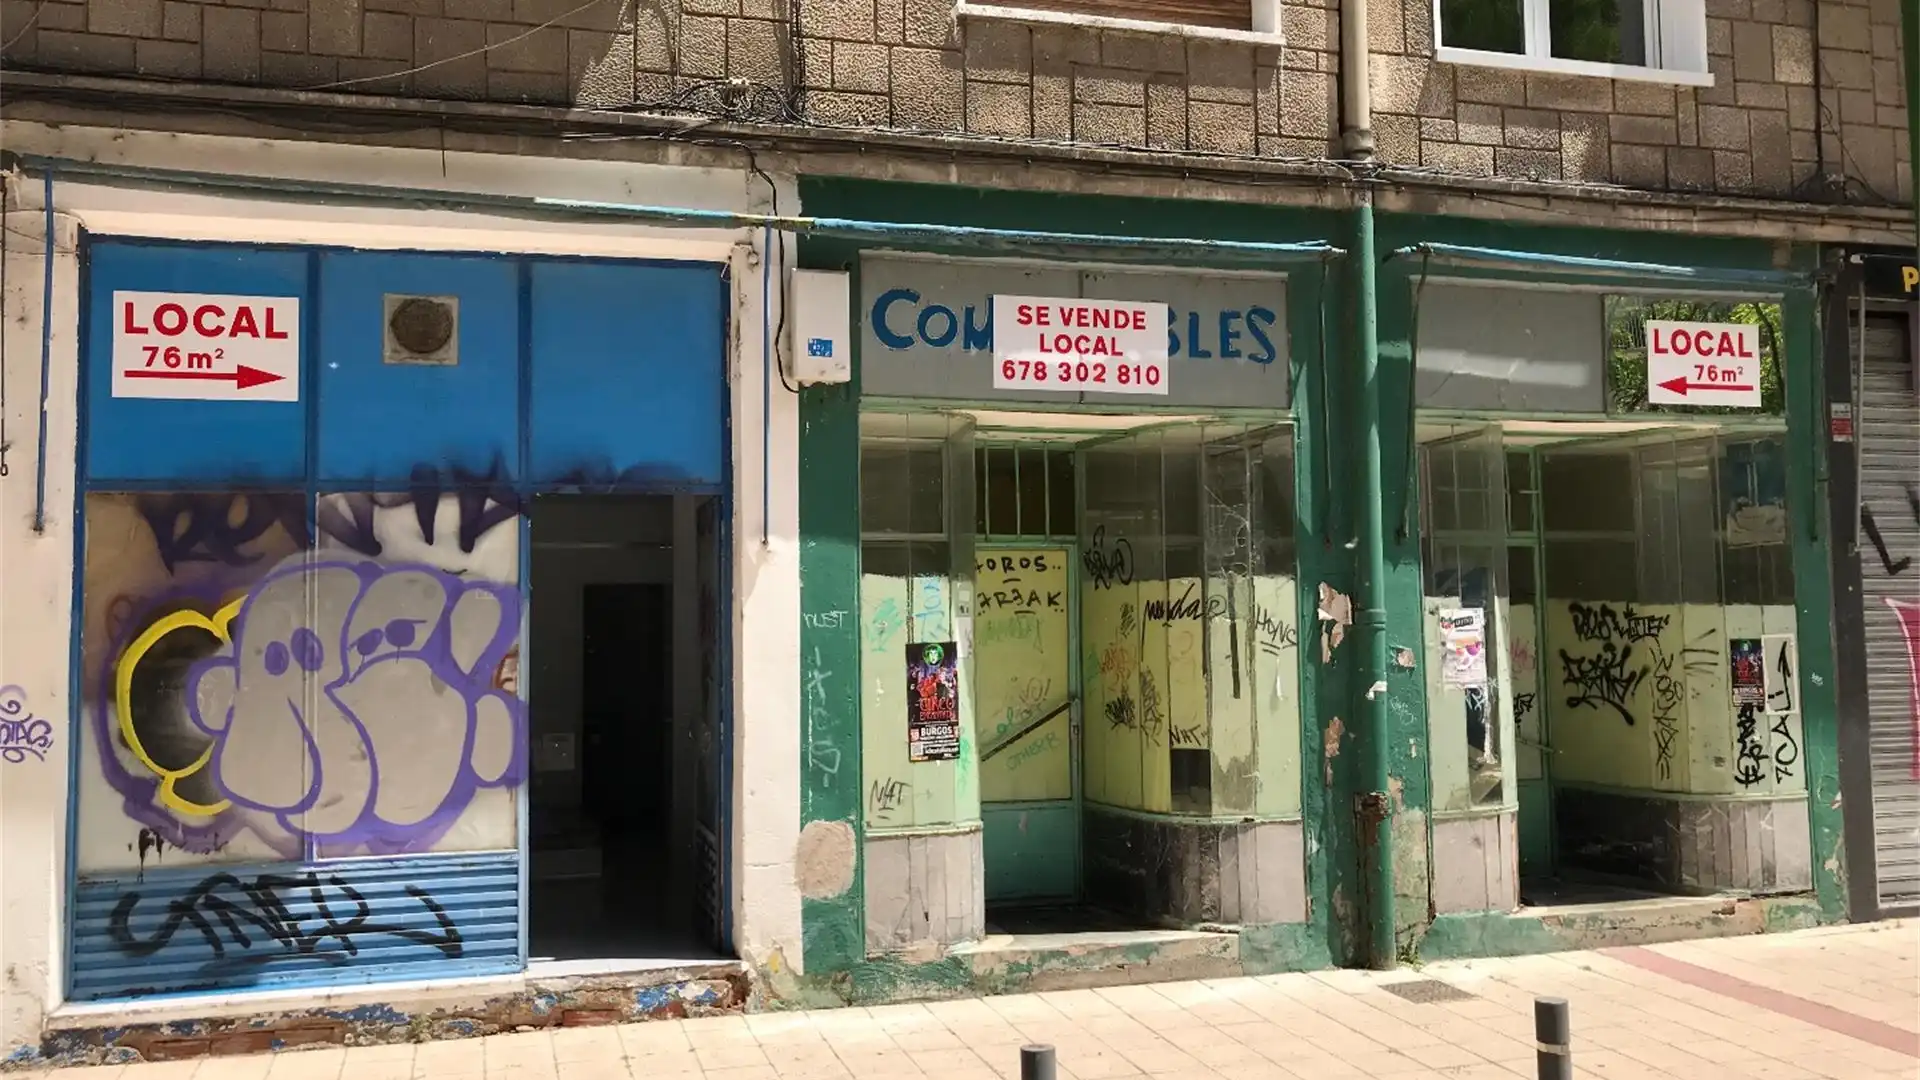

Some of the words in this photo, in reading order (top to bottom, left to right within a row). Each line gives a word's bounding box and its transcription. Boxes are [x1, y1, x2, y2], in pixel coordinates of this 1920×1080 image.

[125, 301, 288, 339] LOCAL
[1017, 304, 1050, 326] SE
[1059, 306, 1146, 330] VENDE
[1039, 333, 1124, 356] LOCAL
[1653, 328, 1753, 358] LOCAL
[1002, 360, 1047, 381] 678
[1058, 362, 1106, 383] 302
[1117, 364, 1160, 386] 810
[920, 726, 953, 737] BURGOS
